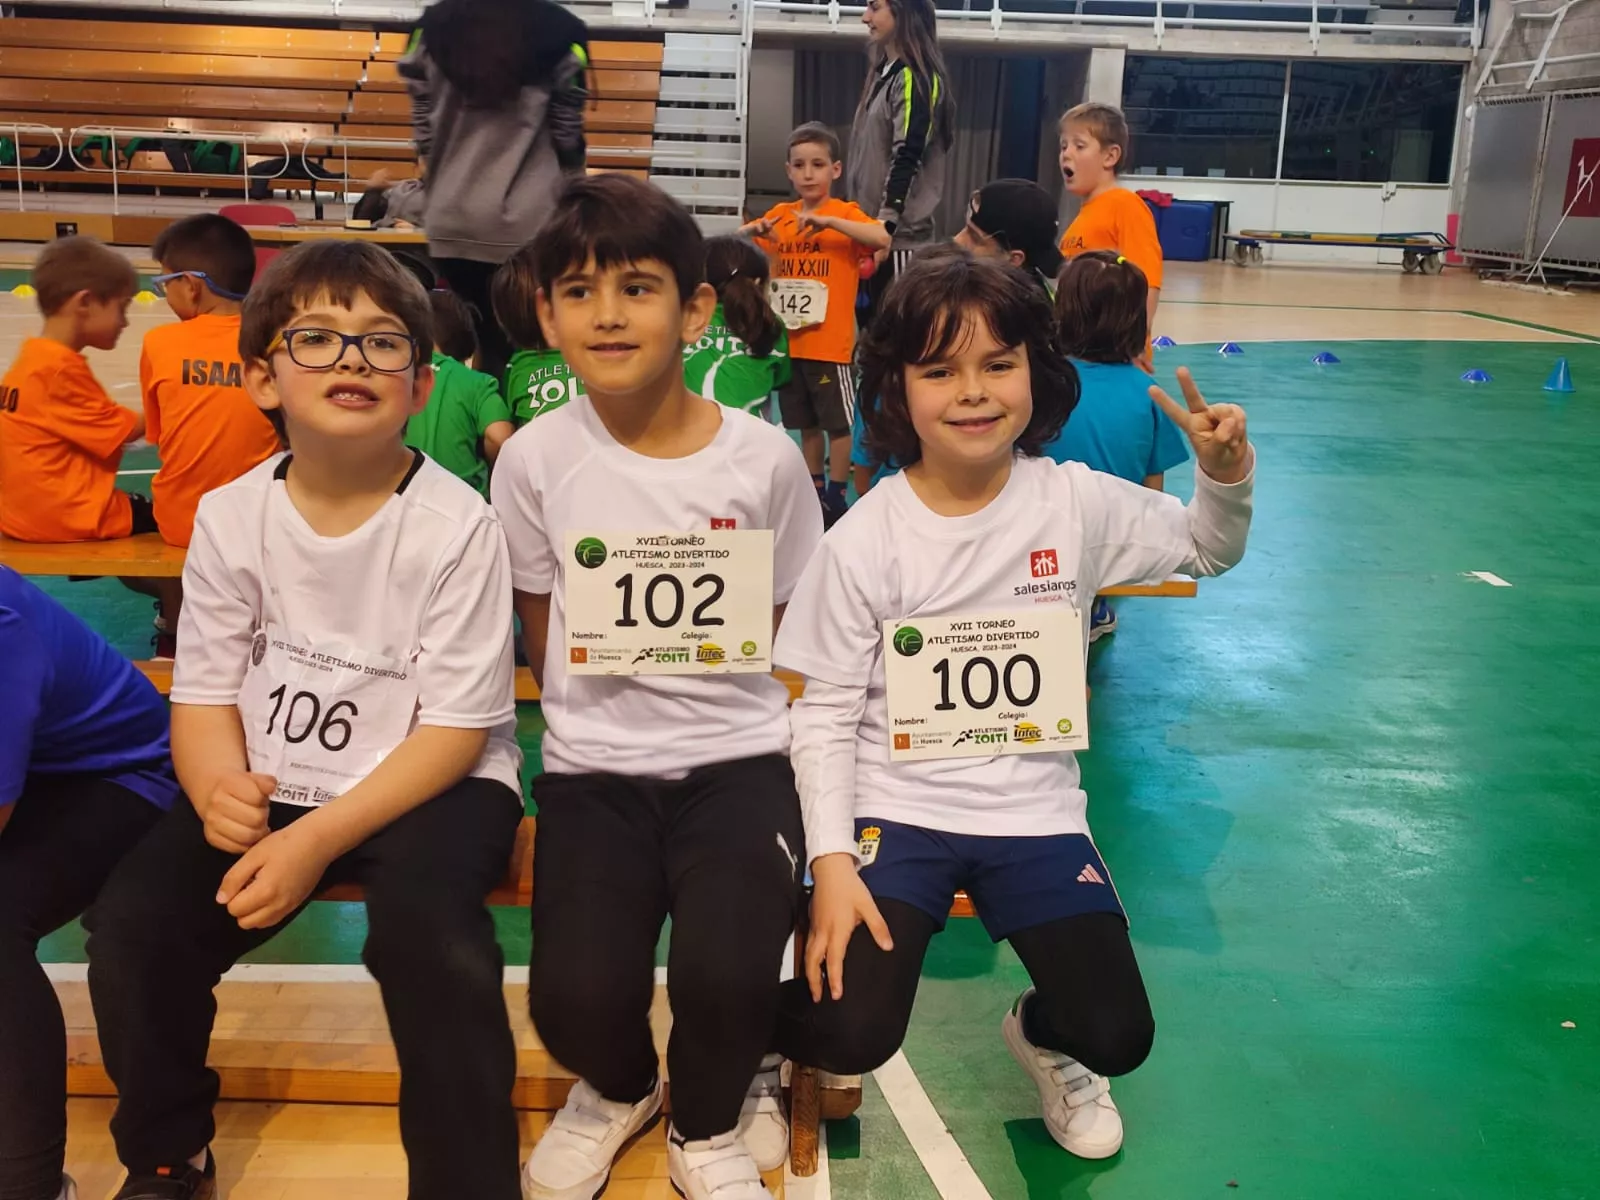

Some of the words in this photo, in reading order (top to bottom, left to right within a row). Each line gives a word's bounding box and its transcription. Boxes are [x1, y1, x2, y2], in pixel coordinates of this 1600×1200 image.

[797, 257, 829, 277] XXIII
[779, 294, 812, 314] 142
[181, 358, 241, 389] ISAA
[528, 363, 570, 385] ATLET
[527, 376, 584, 409] ZOI
[611, 550, 670, 559] ATLETISMO
[674, 550, 730, 559] DIVERTIDO
[1013, 580, 1077, 596] salesianos
[614, 573, 725, 628] 102
[950, 622, 973, 631] XVII
[977, 619, 1016, 629] TORNEO
[927, 633, 983, 645] ATLETISMO
[986, 630, 1040, 642] DIVERTIDO
[982, 643, 1017, 651] 2023-2024
[310, 652, 361, 671] ATLETISMO
[364, 665, 408, 681] DIVERTIDO
[654, 652, 690, 663] ZOITI
[932, 653, 1041, 711] 100
[266, 683, 358, 751] 106
[894, 717, 928, 727] Nombre:
[998, 712, 1029, 721] Colegio:
[974, 733, 1008, 745] ZOITI
